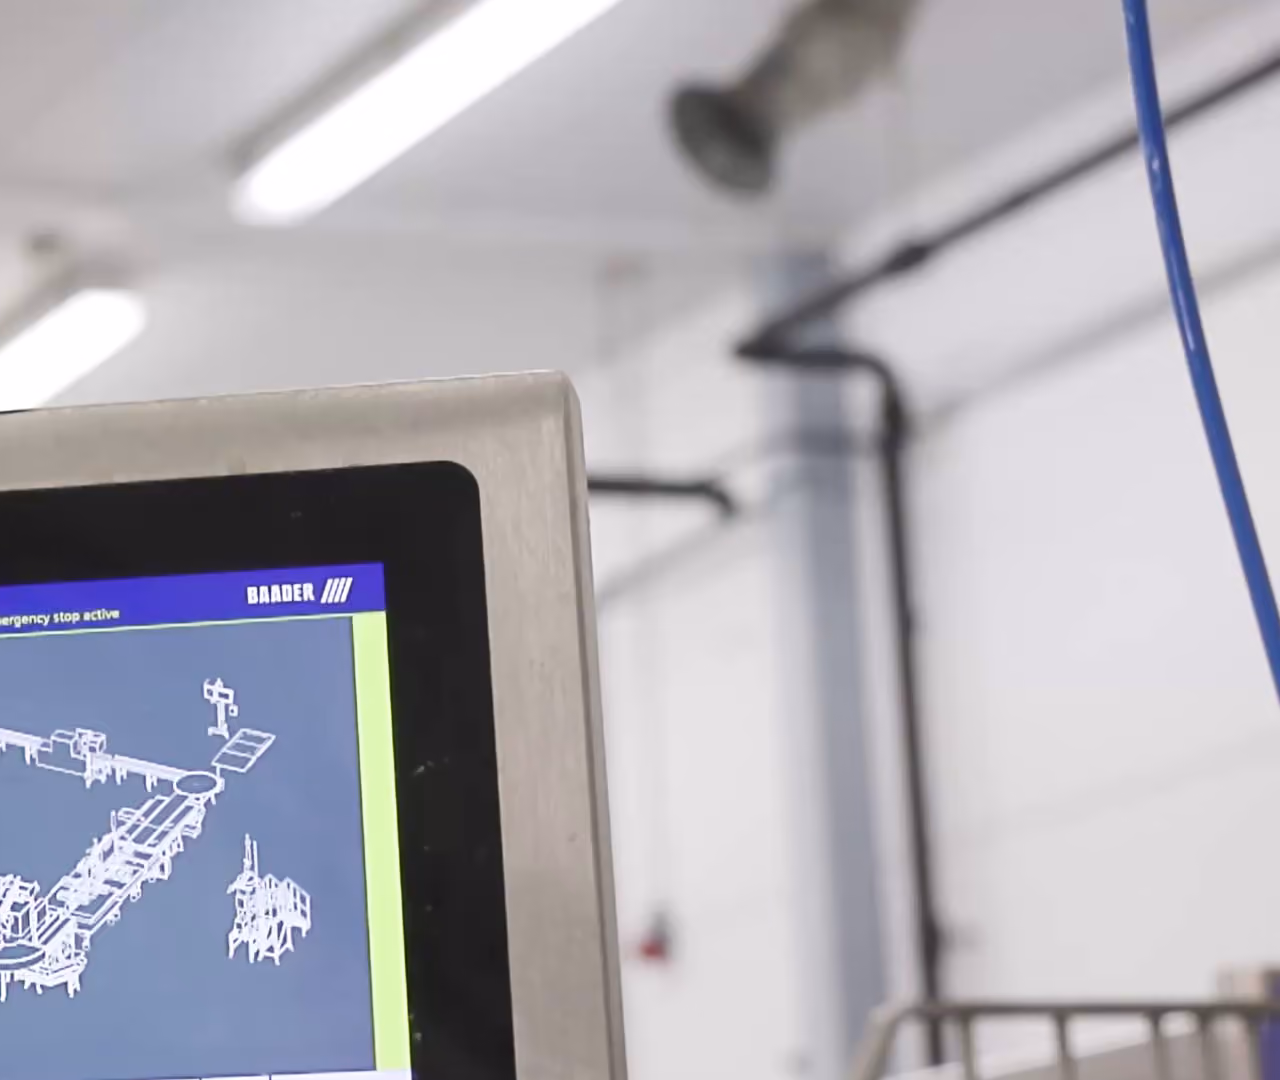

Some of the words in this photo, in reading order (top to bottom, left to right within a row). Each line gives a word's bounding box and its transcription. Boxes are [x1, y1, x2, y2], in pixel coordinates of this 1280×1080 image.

[247, 582, 316, 605] BAADER
[53, 611, 80, 625] stop
[82, 608, 120, 622] active
